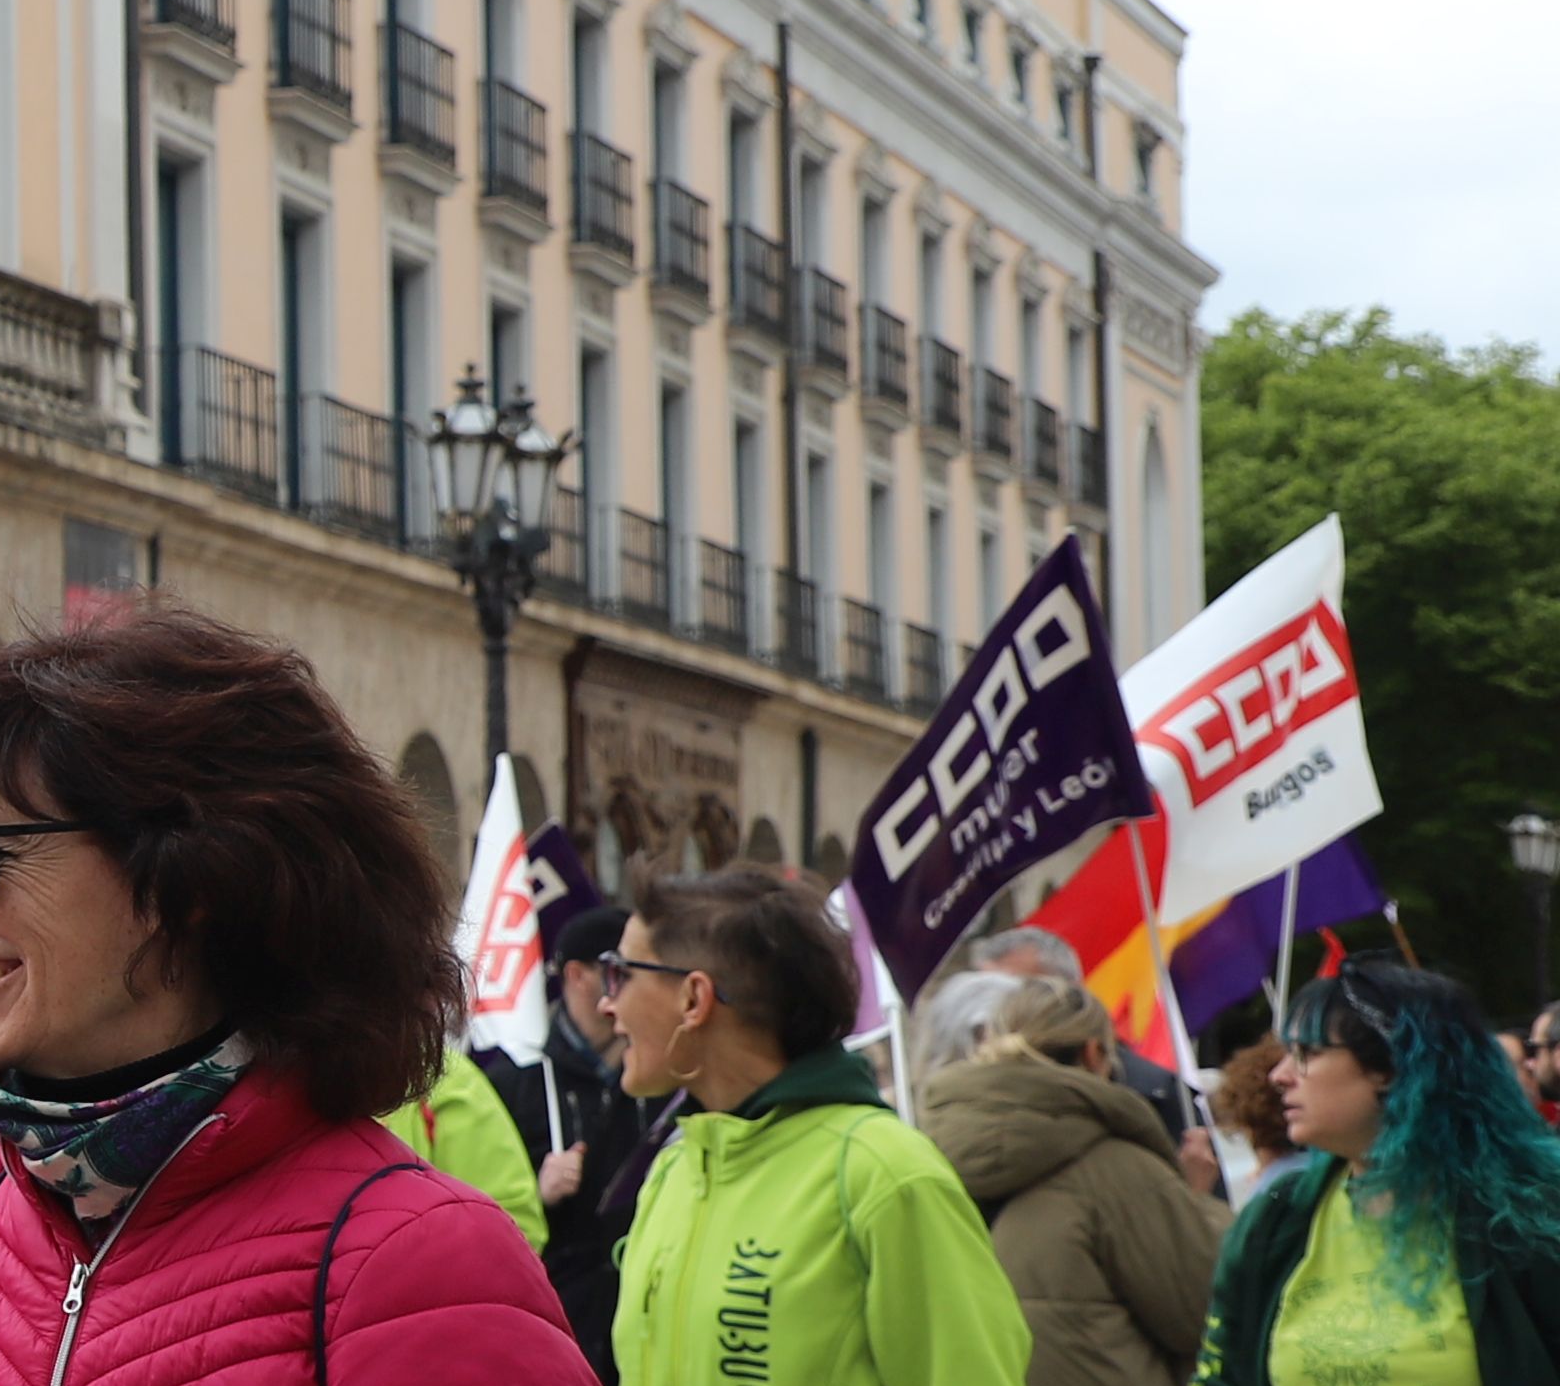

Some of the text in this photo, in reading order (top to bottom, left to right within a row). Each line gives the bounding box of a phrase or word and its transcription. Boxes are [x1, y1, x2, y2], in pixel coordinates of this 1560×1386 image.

[872, 583, 1091, 882] CCOO
[1163, 618, 1345, 780] CCOO
[1017, 814, 1039, 842] y
[1245, 748, 1335, 820] Burgos
